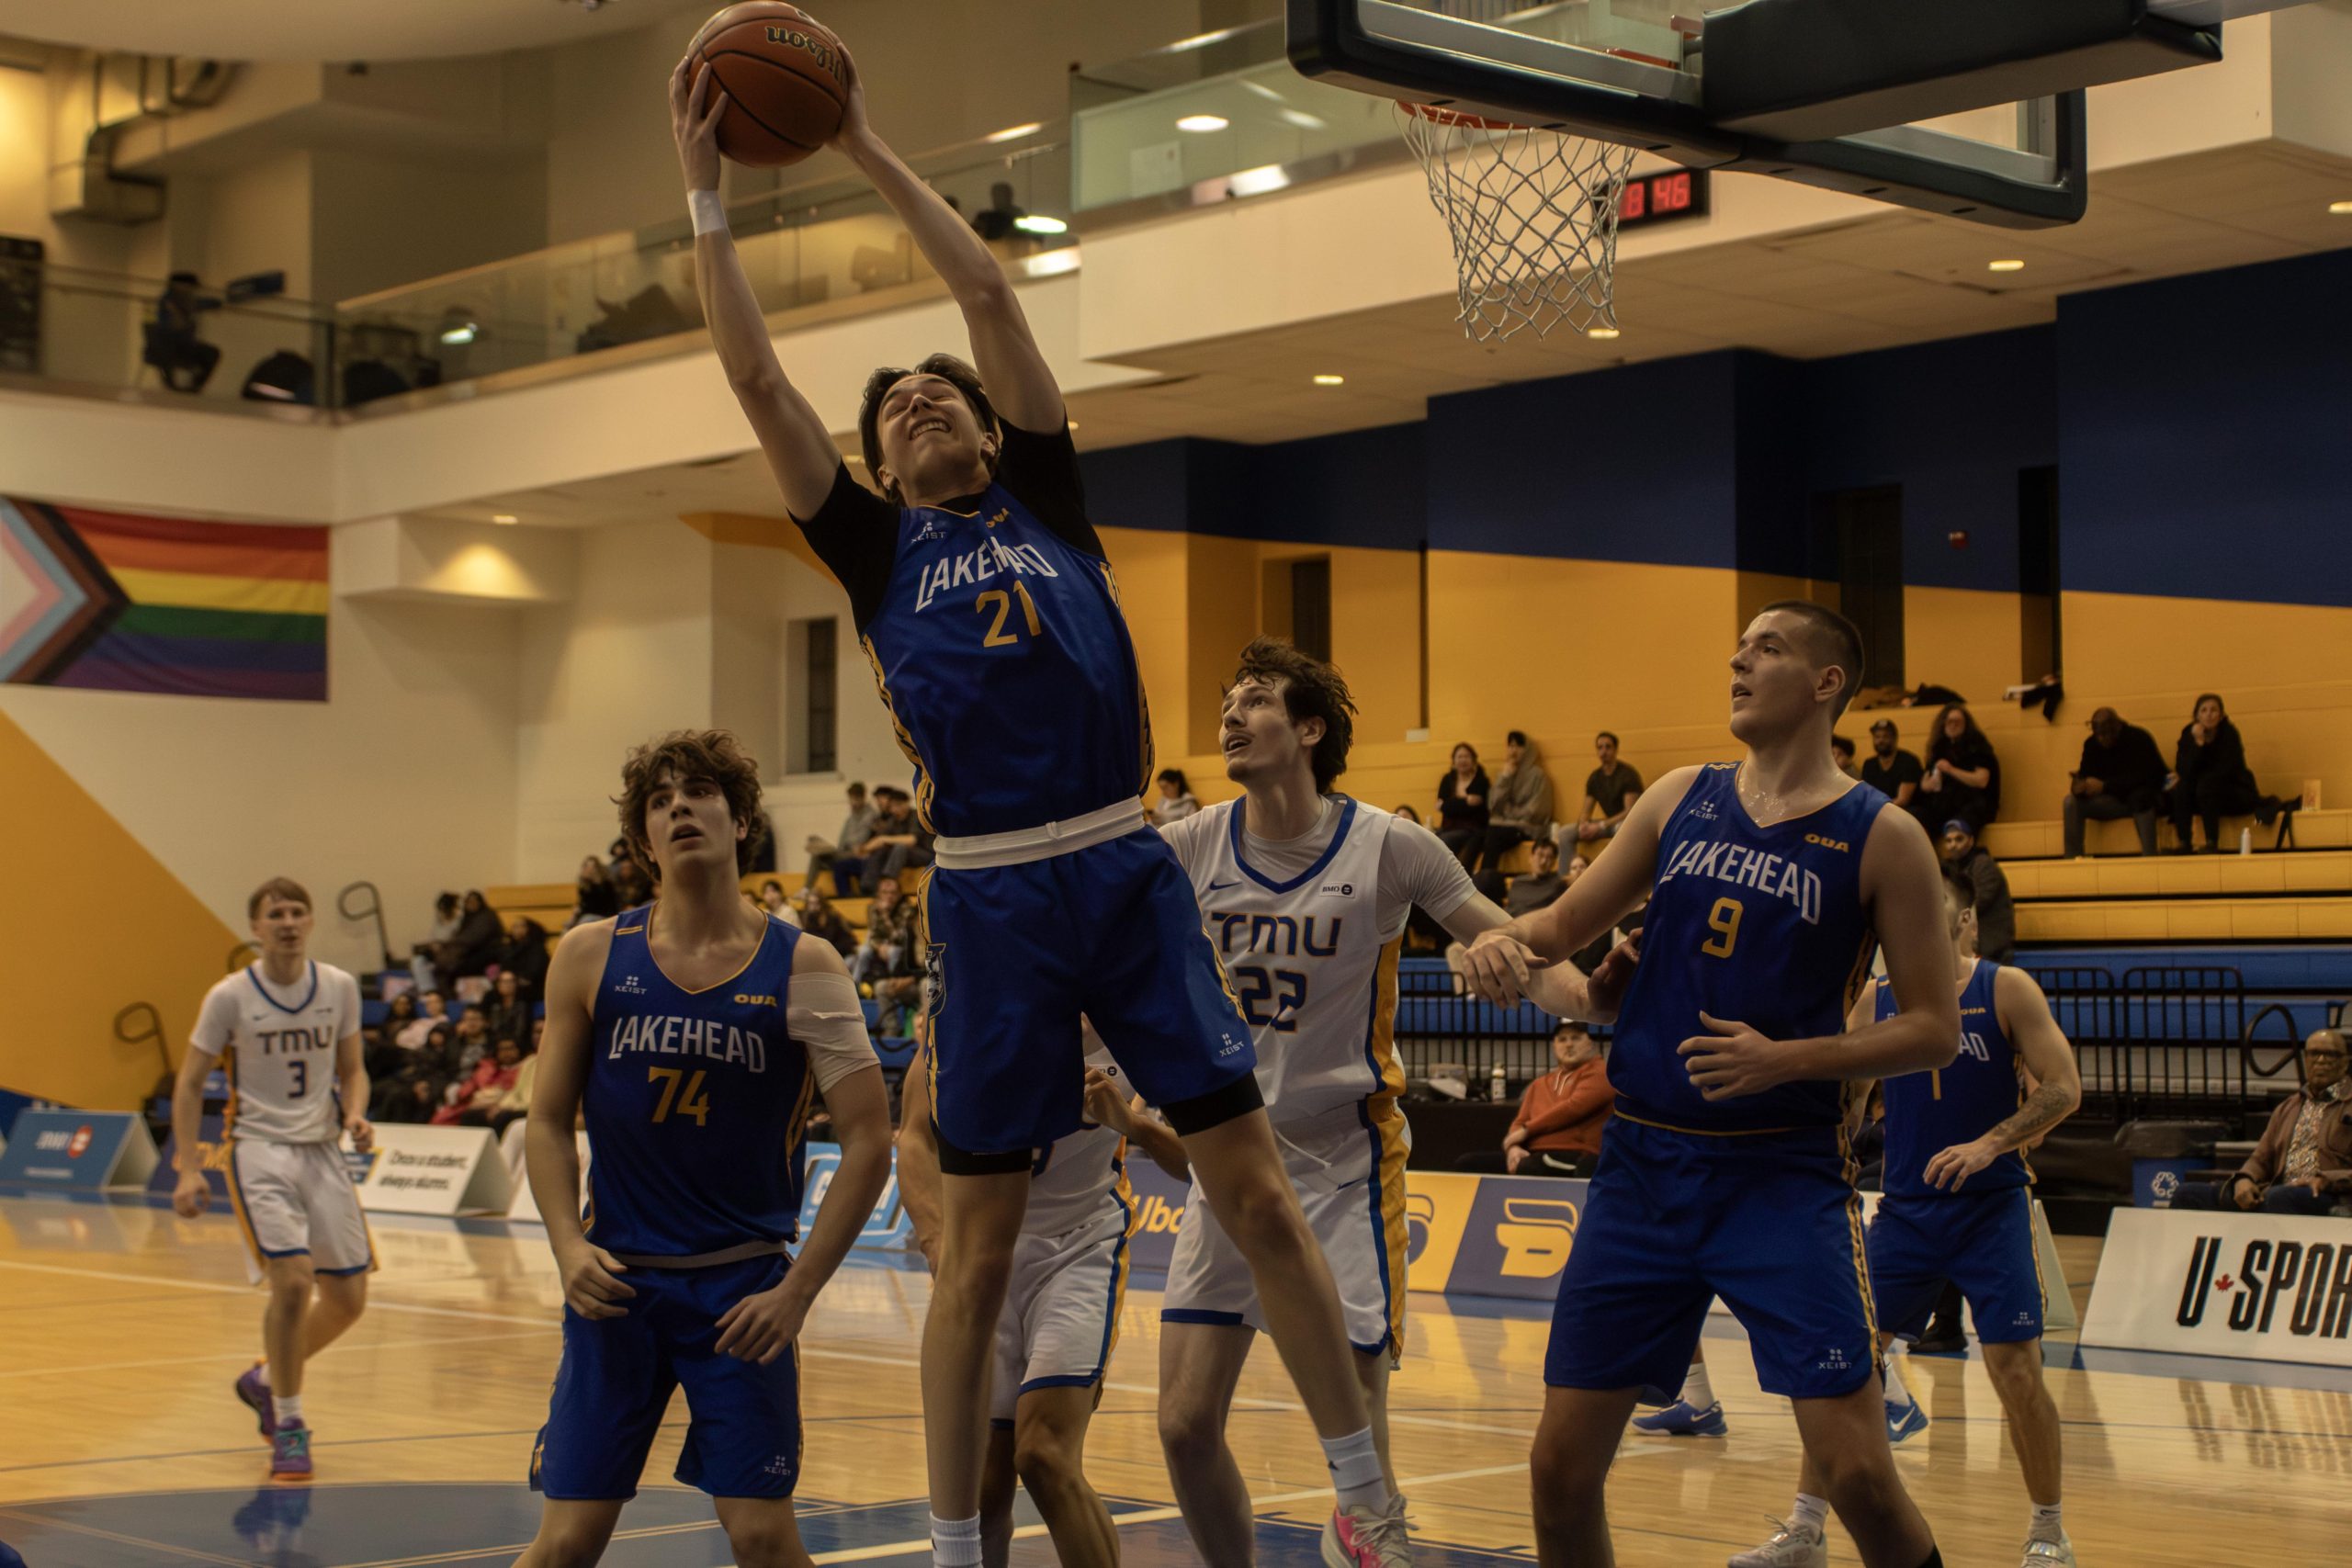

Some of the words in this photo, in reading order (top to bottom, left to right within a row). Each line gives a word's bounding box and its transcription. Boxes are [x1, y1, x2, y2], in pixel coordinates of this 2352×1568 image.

[1652, 172, 1690, 214] 46
[976, 580, 1042, 648] 21
[1804, 833, 1849, 853] OUA
[1658, 840, 1822, 926] LAKEHEAD
[1211, 911, 1343, 957] TMU
[1702, 897, 1744, 959] 9
[614, 985, 648, 995] XEIST
[733, 994, 778, 1007] OUA
[1234, 966, 1308, 1034] 22
[256, 1025, 333, 1055] TMU
[608, 1015, 766, 1073] LAKEHEAD
[1219, 1040, 1245, 1057] XEIST
[288, 1060, 307, 1100] 3
[647, 1066, 710, 1127] 74
[2176, 1235, 2222, 1328] U
